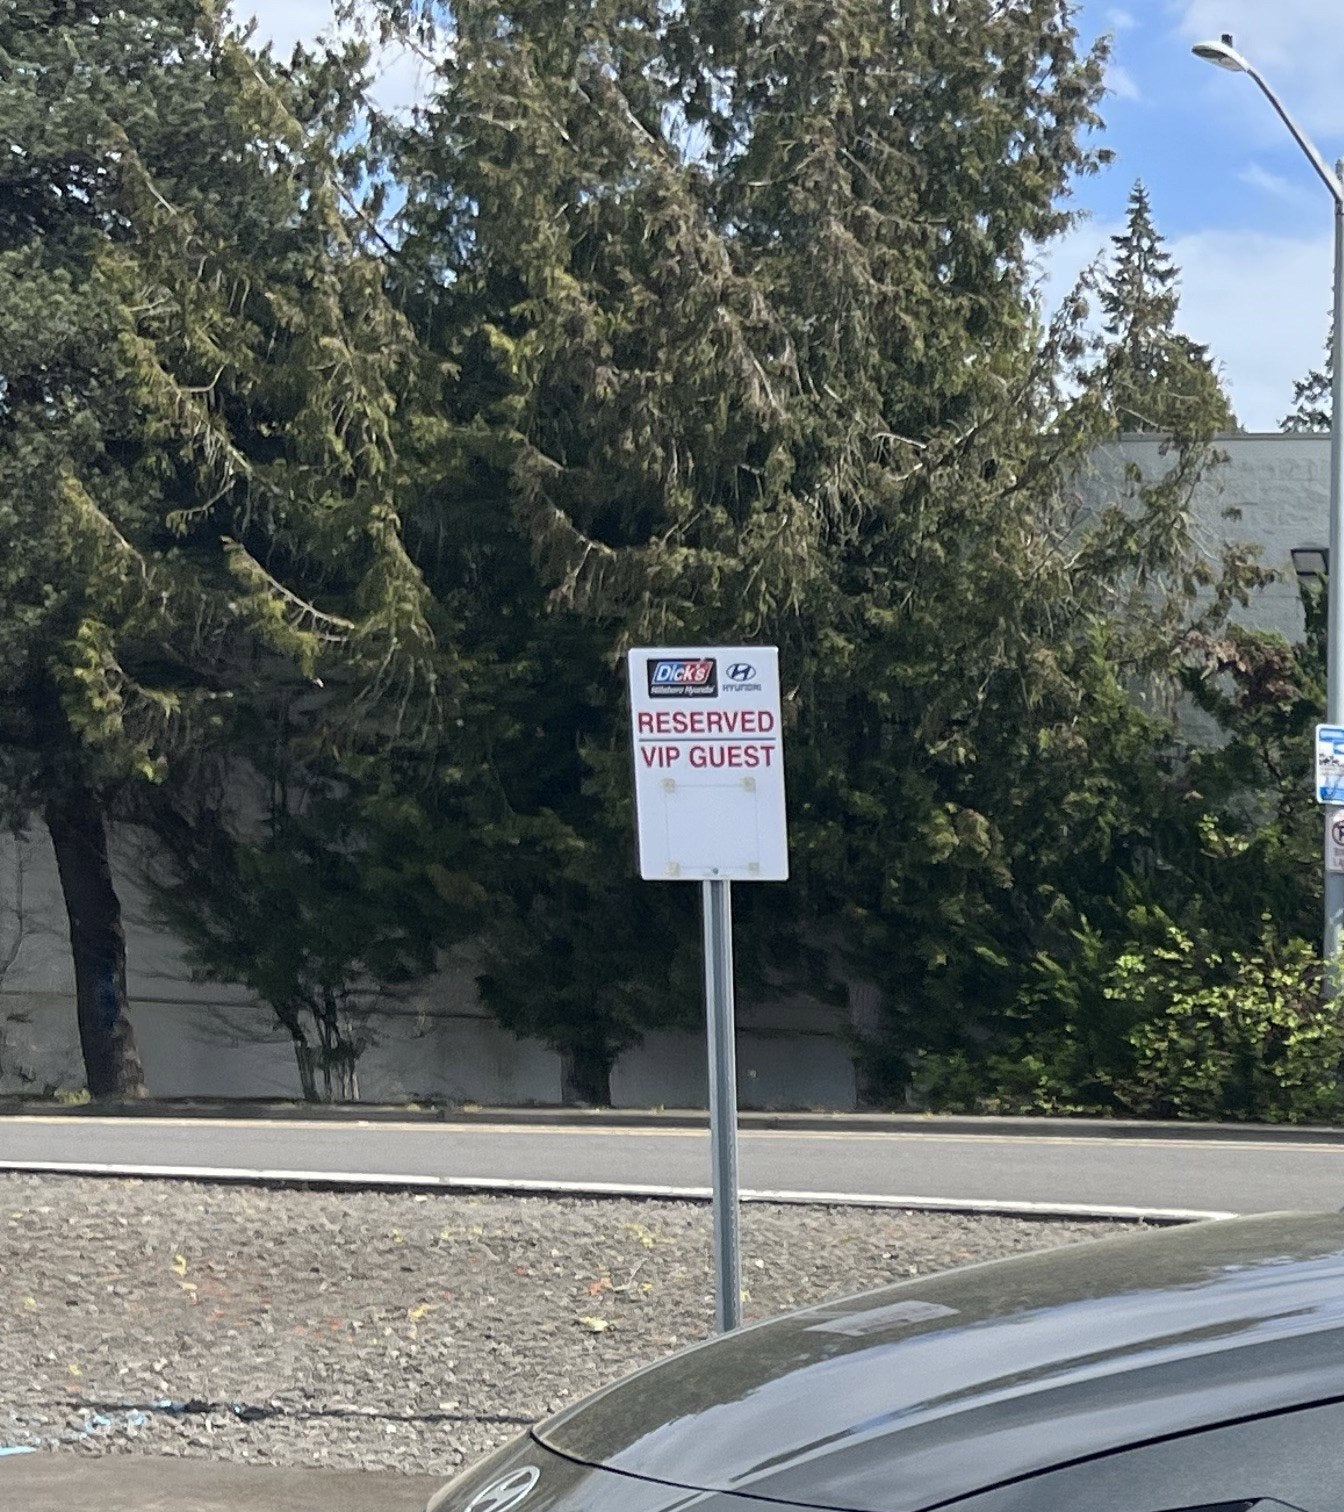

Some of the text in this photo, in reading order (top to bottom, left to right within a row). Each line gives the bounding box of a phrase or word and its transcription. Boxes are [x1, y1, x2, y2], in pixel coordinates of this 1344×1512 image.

[638, 711, 774, 734] RESERVED
[641, 746, 775, 767] VIP GUEST
